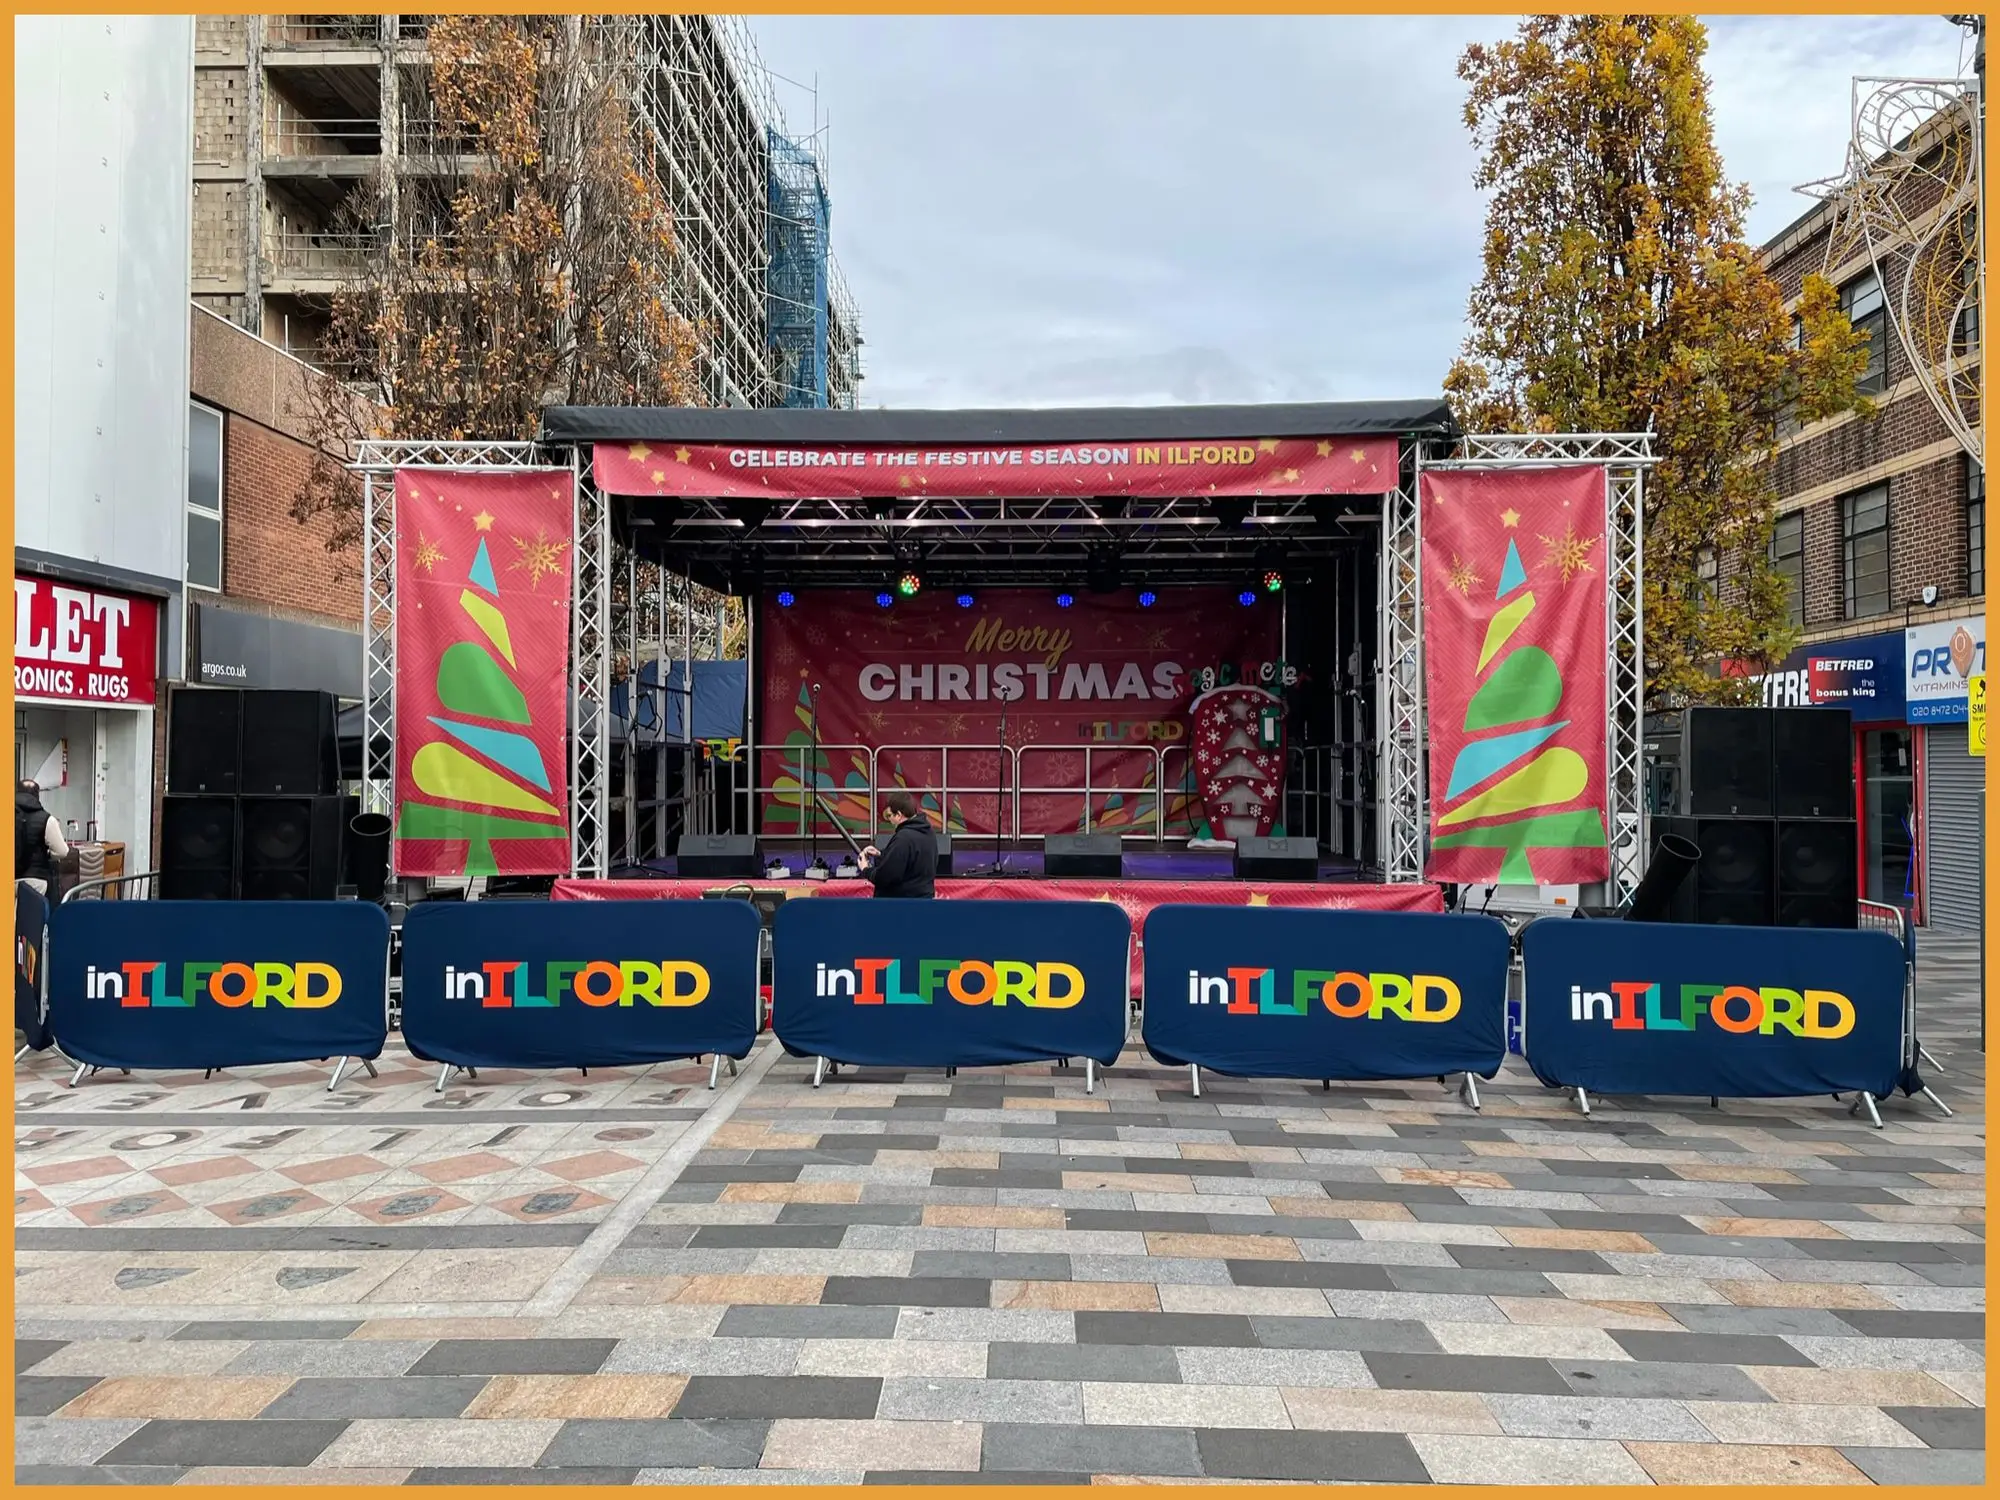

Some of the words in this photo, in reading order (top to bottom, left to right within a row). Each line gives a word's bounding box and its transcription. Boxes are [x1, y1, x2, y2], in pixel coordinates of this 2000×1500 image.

[729, 449, 866, 468] CELEBRATE
[872, 452, 918, 466] THE
[925, 450, 1023, 466] FESTIVE
[1029, 448, 1130, 465] SEASON
[1136, 447, 1161, 465] IN
[1167, 446, 1256, 465] ILFORD
[15, 578, 130, 669] LET
[965, 617, 1073, 670] Merry
[202, 663, 247, 678] argos.co.uk
[1815, 659, 1874, 672] BETFRED
[15, 666, 73, 694] RONICS
[88, 673, 129, 698] RUGS
[858, 661, 1184, 701] CHRISTMAS
[1861, 678, 1875, 687] the
[1913, 680, 1969, 693] VITAMINS
[1815, 688, 1849, 697] bonus
[1852, 687, 1876, 698] king
[1912, 707, 1929, 717] 020
[1931, 705, 1950, 716] 8472
